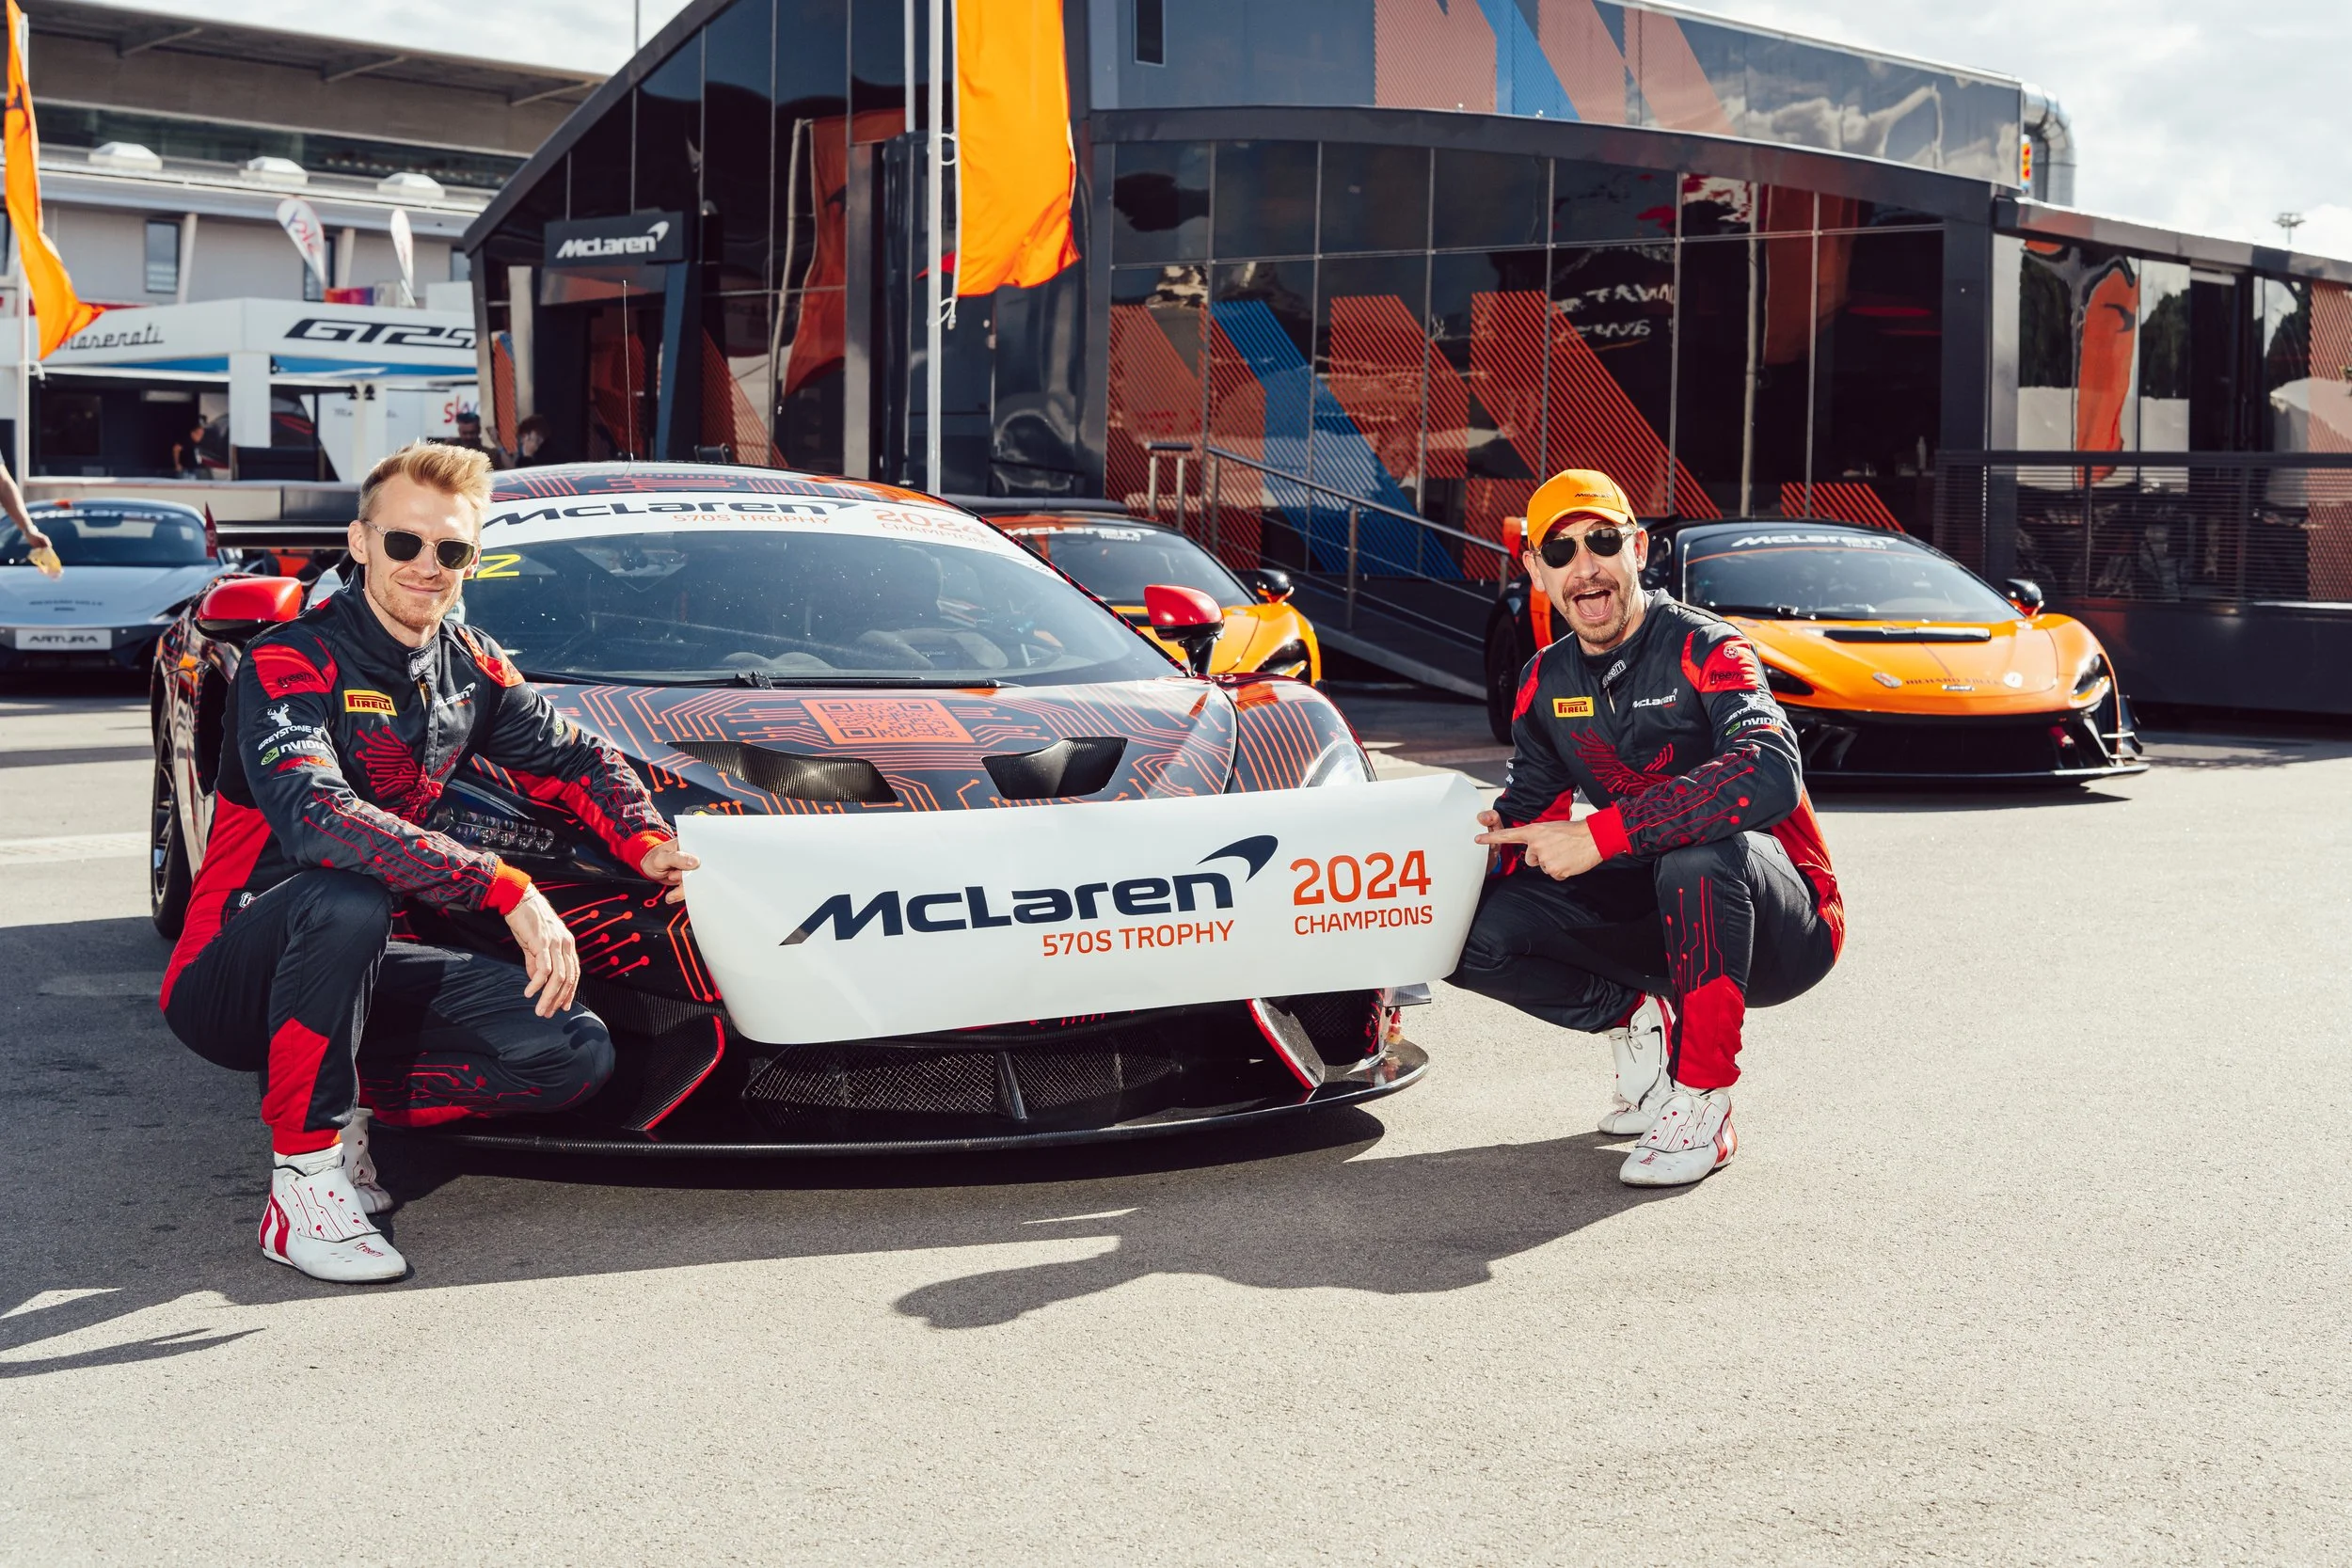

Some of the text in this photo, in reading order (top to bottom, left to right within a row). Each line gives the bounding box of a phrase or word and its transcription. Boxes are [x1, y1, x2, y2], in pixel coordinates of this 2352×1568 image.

[556, 235, 656, 259] McLaren
[482, 501, 827, 530] McLaren
[673, 514, 831, 525] 570S TROPHY
[871, 508, 988, 539] 2024
[28, 635, 99, 643] ARTURA
[347, 695, 392, 710] PIRELLI
[1632, 694, 1677, 708] McLaren
[258, 725, 312, 751] GREYSTONE
[1290, 850, 1433, 906] 2024
[782, 871, 1234, 945] McLaren
[1294, 905, 1433, 936] CHAMPIONS
[1042, 920, 1235, 957] 570S TROPHY
